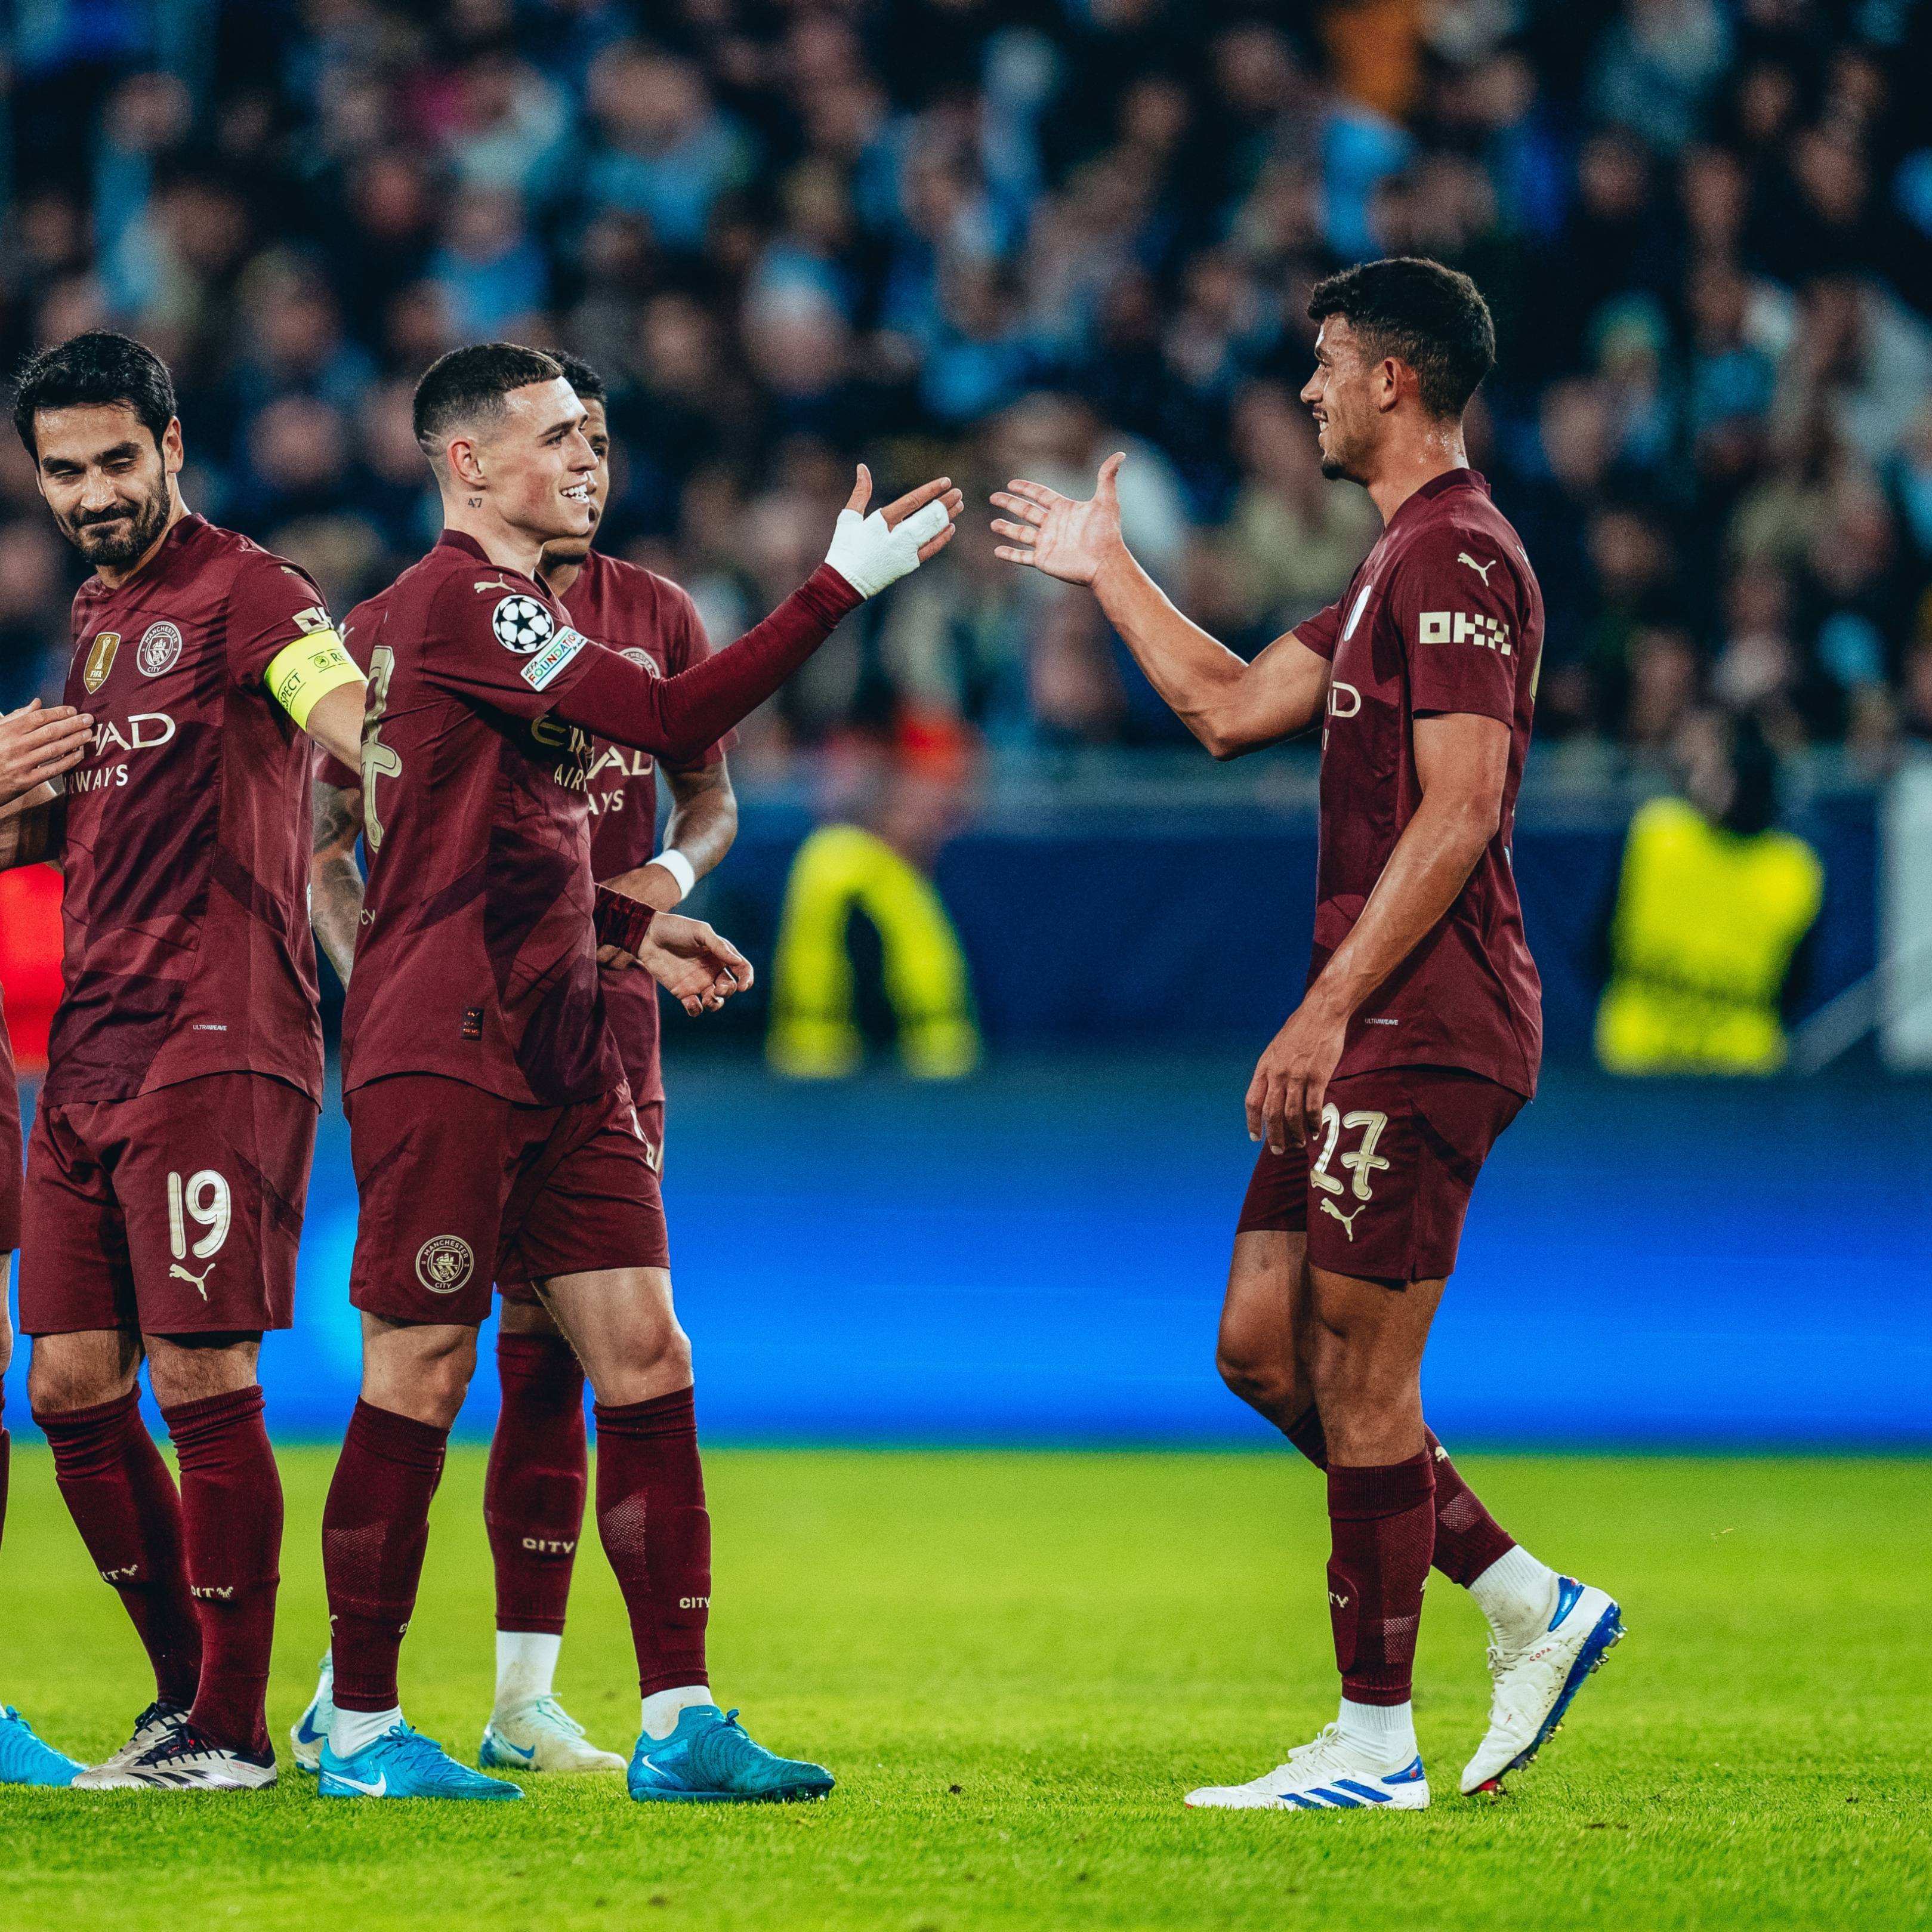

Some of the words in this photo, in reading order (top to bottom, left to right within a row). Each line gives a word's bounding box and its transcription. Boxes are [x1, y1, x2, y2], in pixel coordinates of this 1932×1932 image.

[468, 498, 482, 508] 47
[145, 626, 178, 643] MANCHESTER
[523, 661, 539, 676] UEFA
[280, 672, 301, 711] SPECT
[585, 745, 654, 780] AD
[554, 763, 586, 792] AIR
[1310, 1103, 1390, 1200] 27
[167, 1169, 231, 1260] 19
[424, 1239, 468, 1258] MANCHESTER
[523, 1538, 574, 1554] CITY
[101, 1564, 138, 1581] ITY
[680, 1597, 710, 1609] CITY
[1328, 1591, 1348, 1608] TY
[1529, 1647, 1551, 1662] COPA
